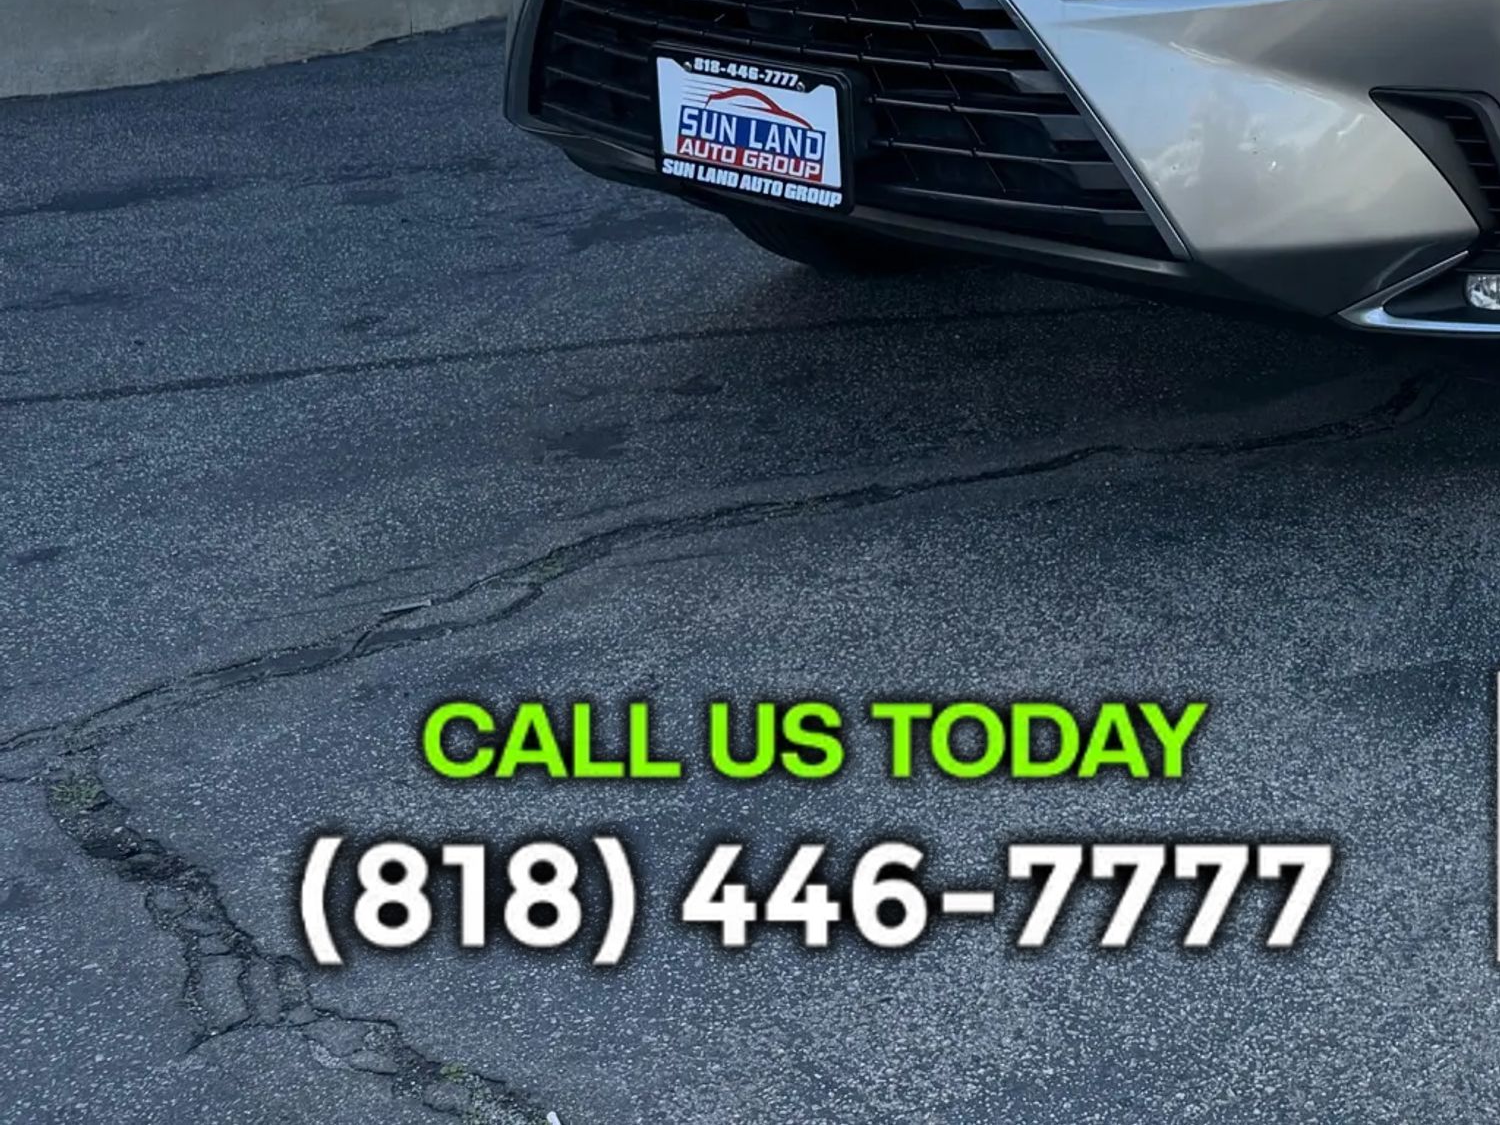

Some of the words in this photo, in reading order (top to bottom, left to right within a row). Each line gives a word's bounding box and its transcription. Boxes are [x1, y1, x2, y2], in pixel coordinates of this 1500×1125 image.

[693, 57, 799, 87] 818-446-7777
[680, 107, 737, 145] SUN
[749, 120, 823, 161] LAND
[679, 139, 737, 165] AUTO
[742, 150, 821, 179] GROUP
[662, 158, 696, 179] SUN
[697, 166, 739, 189] LAND
[740, 175, 783, 197] AUTO
[784, 183, 842, 207] GROUP
